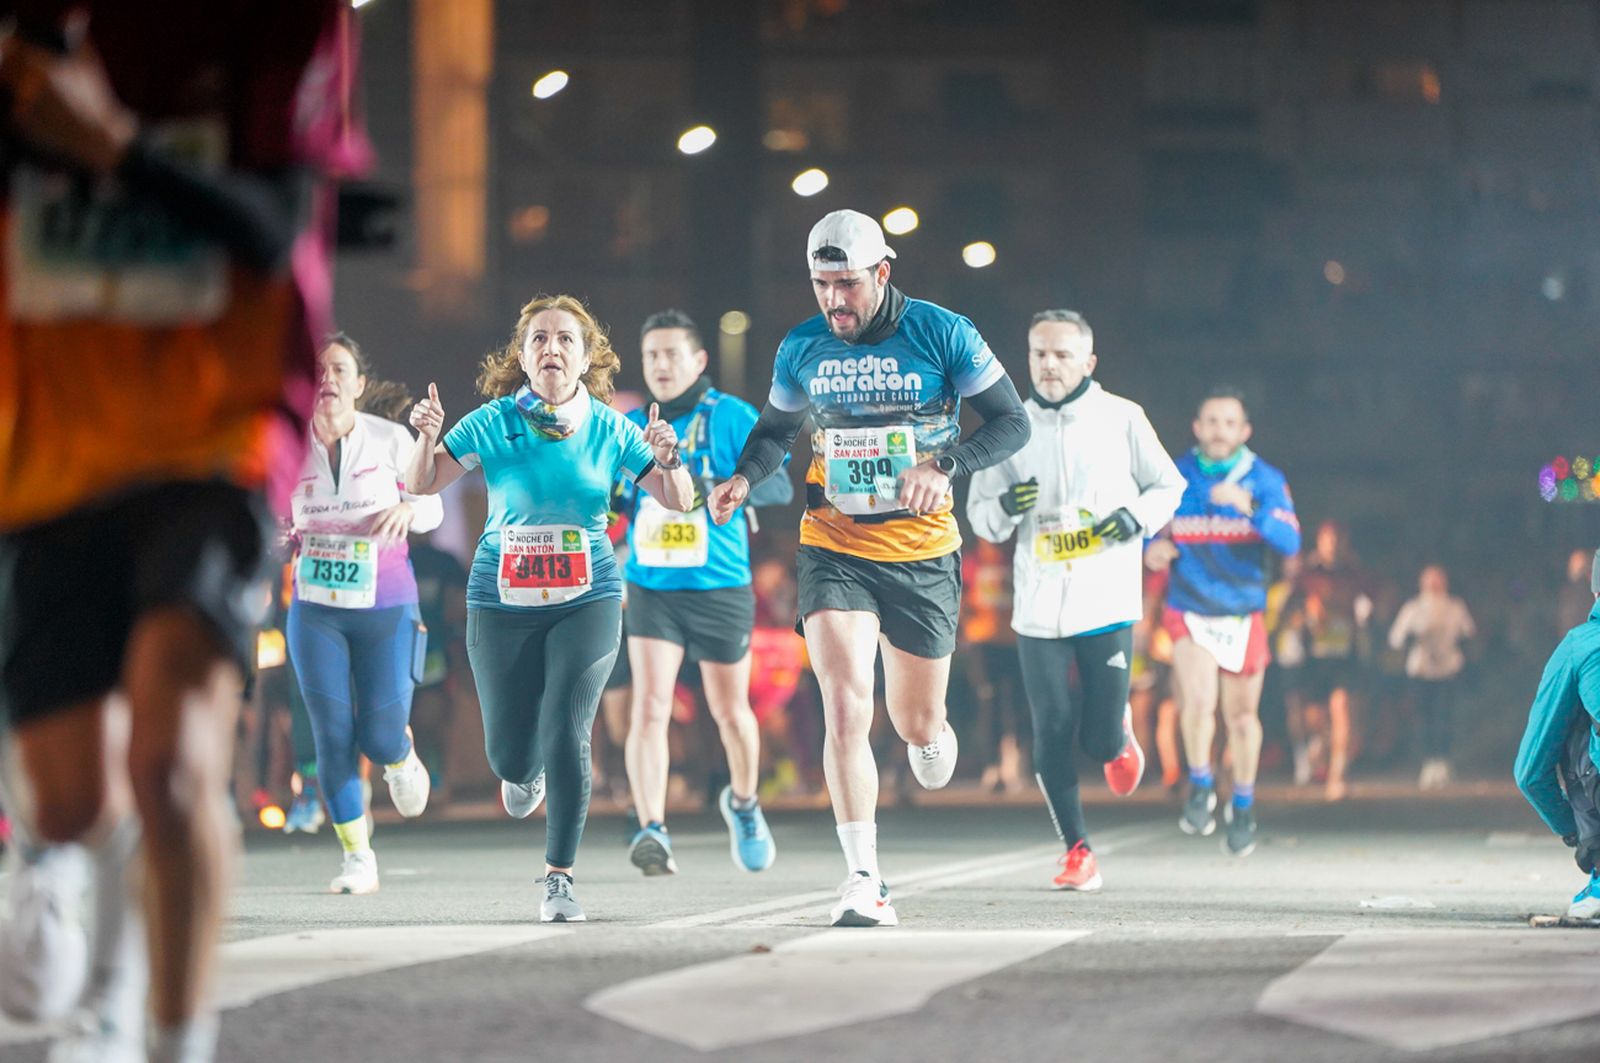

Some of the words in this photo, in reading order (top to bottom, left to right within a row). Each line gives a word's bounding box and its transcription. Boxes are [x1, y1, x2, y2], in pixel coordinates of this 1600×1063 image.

[836, 393, 870, 403] CIUDAD
[875, 392, 886, 402] DE
[843, 438, 866, 447] NOCHE
[868, 438, 878, 446] DE
[834, 449, 850, 458] SAN
[848, 458, 892, 485] 399
[516, 535, 541, 543] NOCHE
[543, 534, 554, 542] DE
[509, 545, 524, 553] SAN
[312, 559, 359, 583] 7332
[516, 554, 572, 579] 9413
